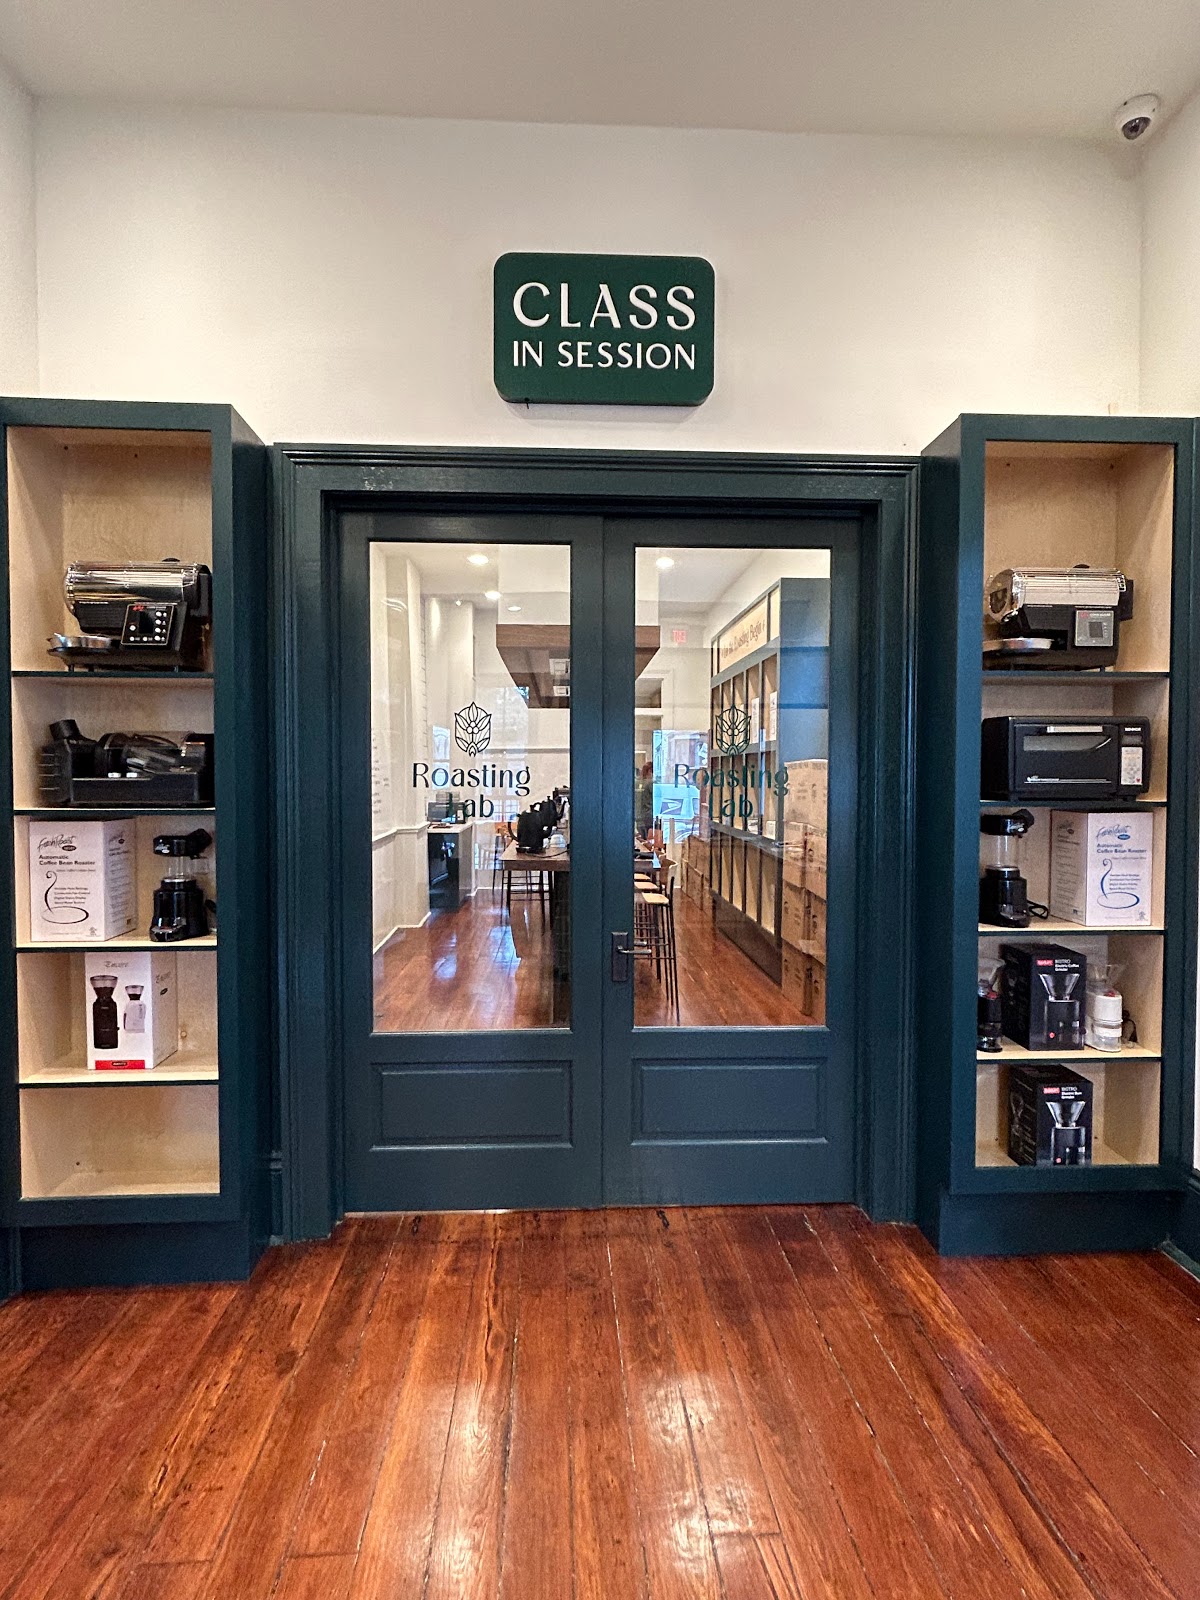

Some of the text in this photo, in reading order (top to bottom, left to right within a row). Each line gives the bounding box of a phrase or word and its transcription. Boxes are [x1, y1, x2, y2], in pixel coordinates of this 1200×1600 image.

[512, 281, 696, 331] CLASS
[513, 340, 696, 370] IN SESSION
[412, 762, 531, 797] Roasting
[674, 763, 789, 797] Roasting
[448, 793, 495, 818] Lab
[708, 792, 754, 818] Lab
